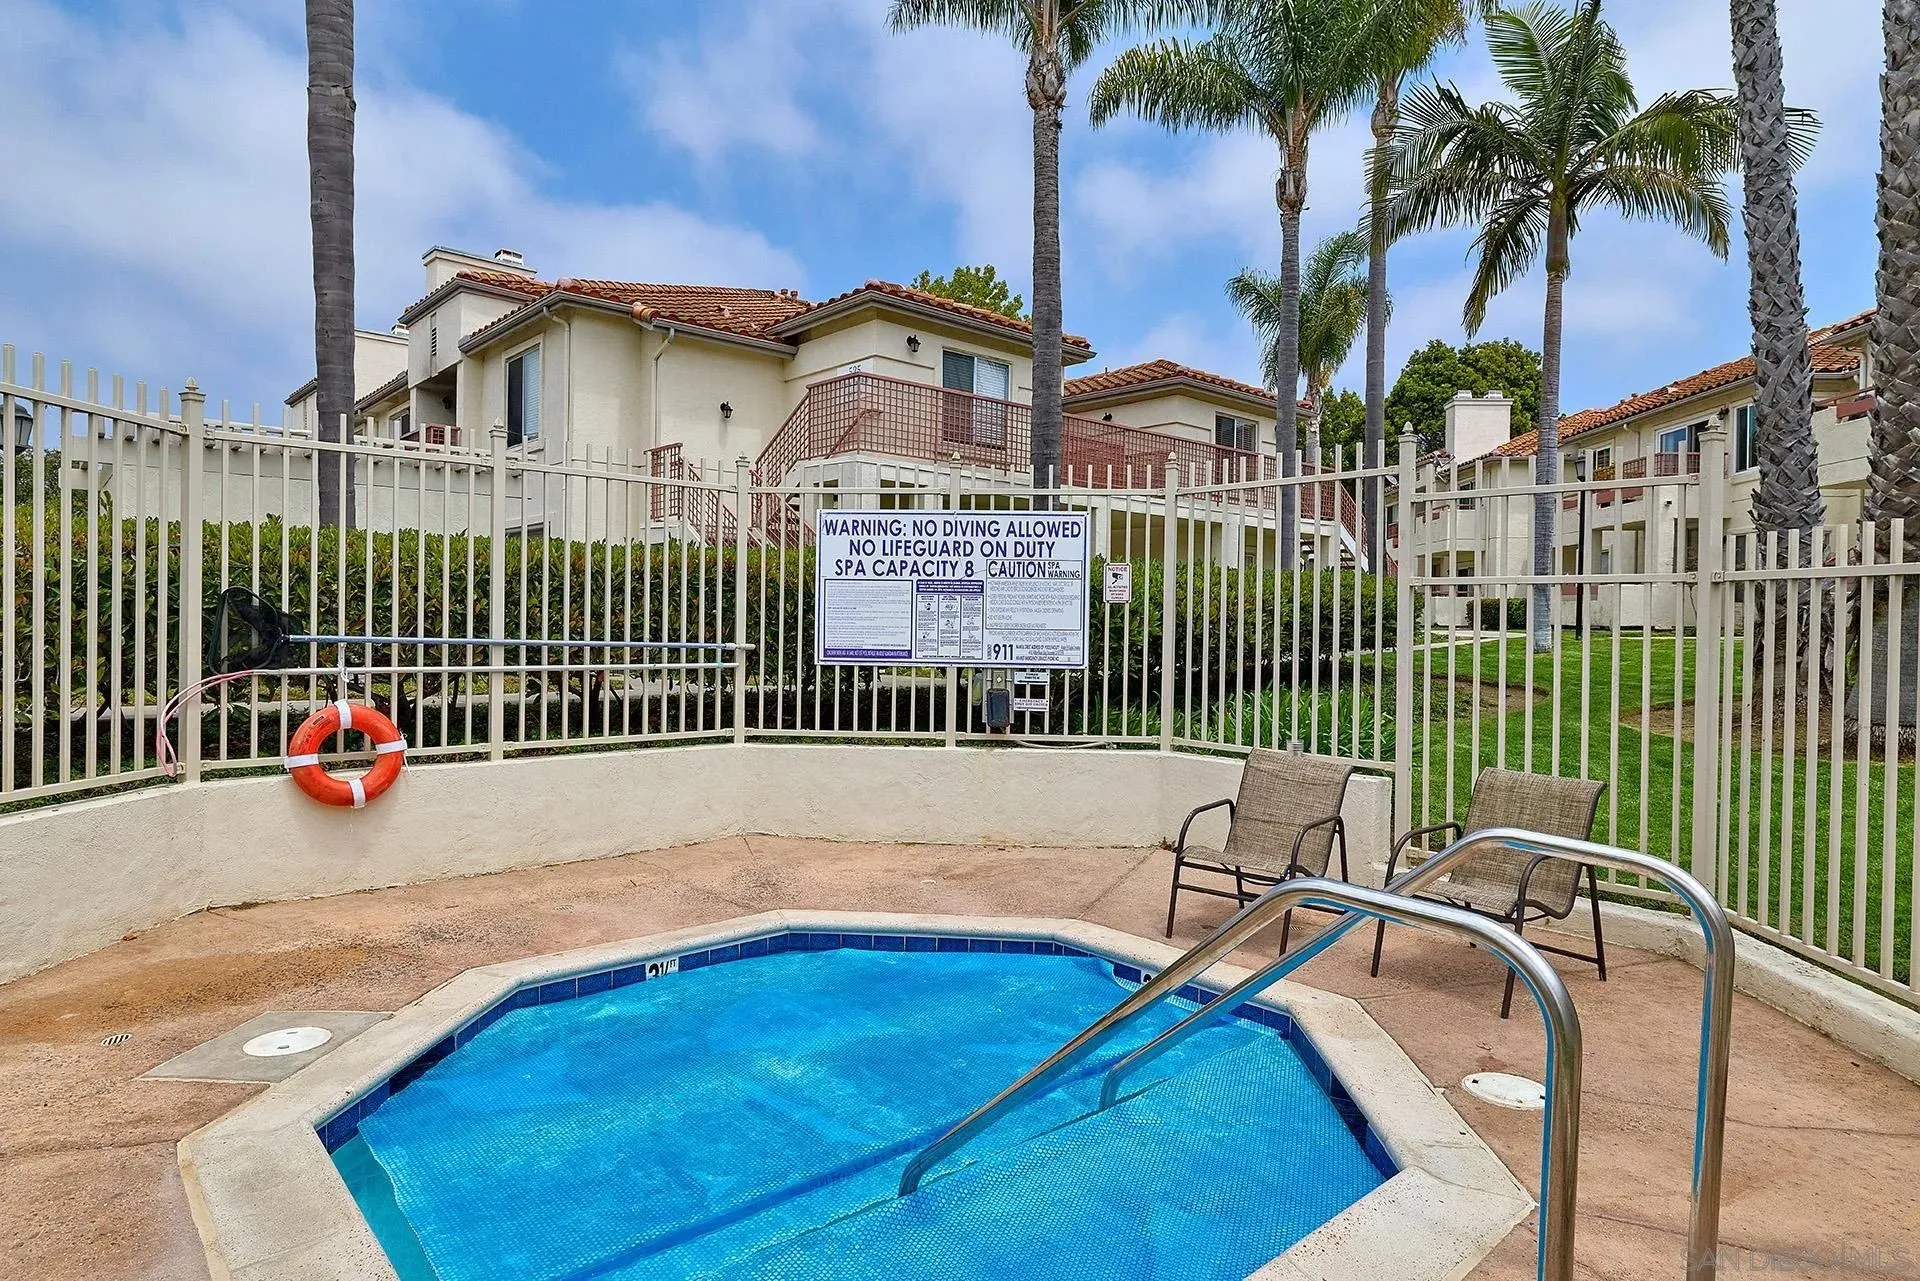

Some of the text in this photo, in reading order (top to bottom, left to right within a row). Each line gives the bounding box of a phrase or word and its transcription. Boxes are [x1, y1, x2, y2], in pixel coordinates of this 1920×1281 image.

[825, 518, 1081, 538] WARNING: NO DIVING ALLOWED
[849, 539, 1055, 558] NO LIFEGUARD ON DUTY
[835, 558, 974, 577] SPA CAPACITY 8
[988, 560, 1046, 578] CAUTION
[1047, 561, 1060, 570] SPA
[1047, 570, 1081, 579] WARNING
[993, 643, 1013, 661] 911
